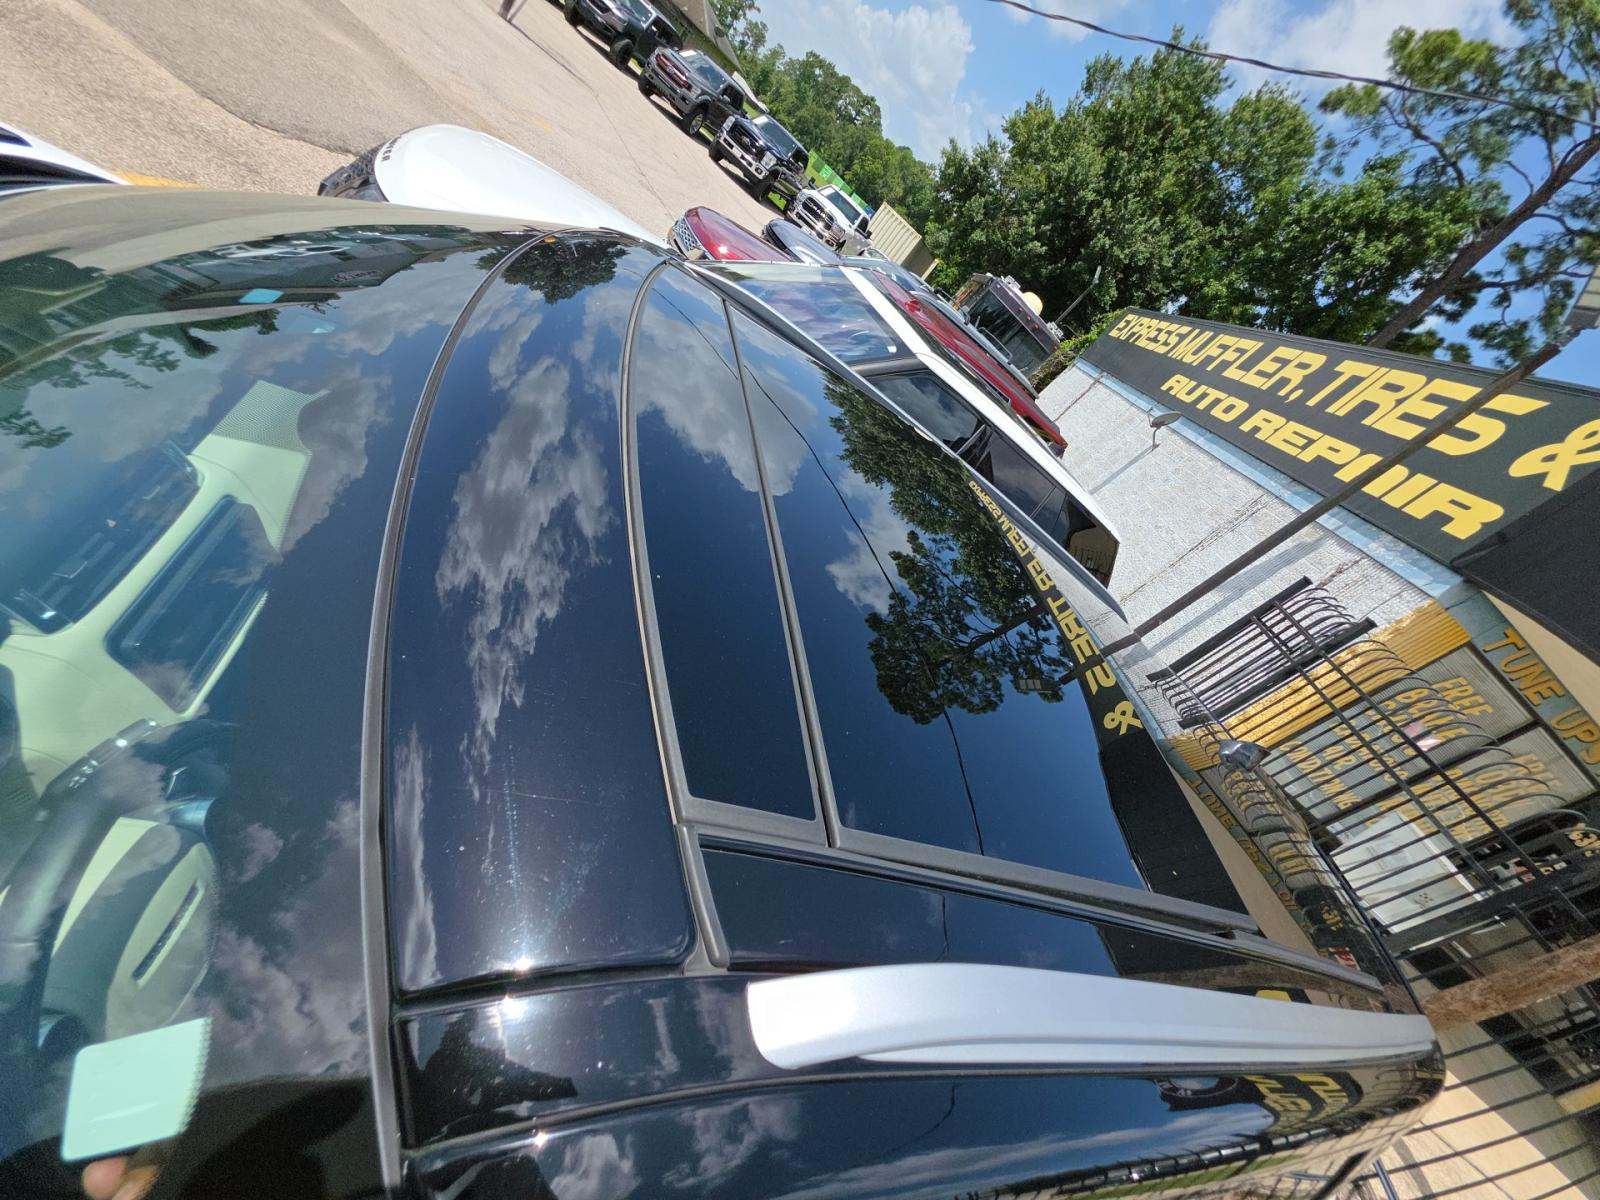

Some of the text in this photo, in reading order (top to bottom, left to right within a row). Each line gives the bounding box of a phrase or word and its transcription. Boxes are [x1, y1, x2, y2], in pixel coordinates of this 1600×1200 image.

[1109, 314, 1600, 492] EXPRESS MUFFLER, TIRES &
[1160, 374, 1505, 540] AUTO REPAIR
[1431, 676, 1494, 717] FREE
[1482, 627, 1566, 706] TUNE
